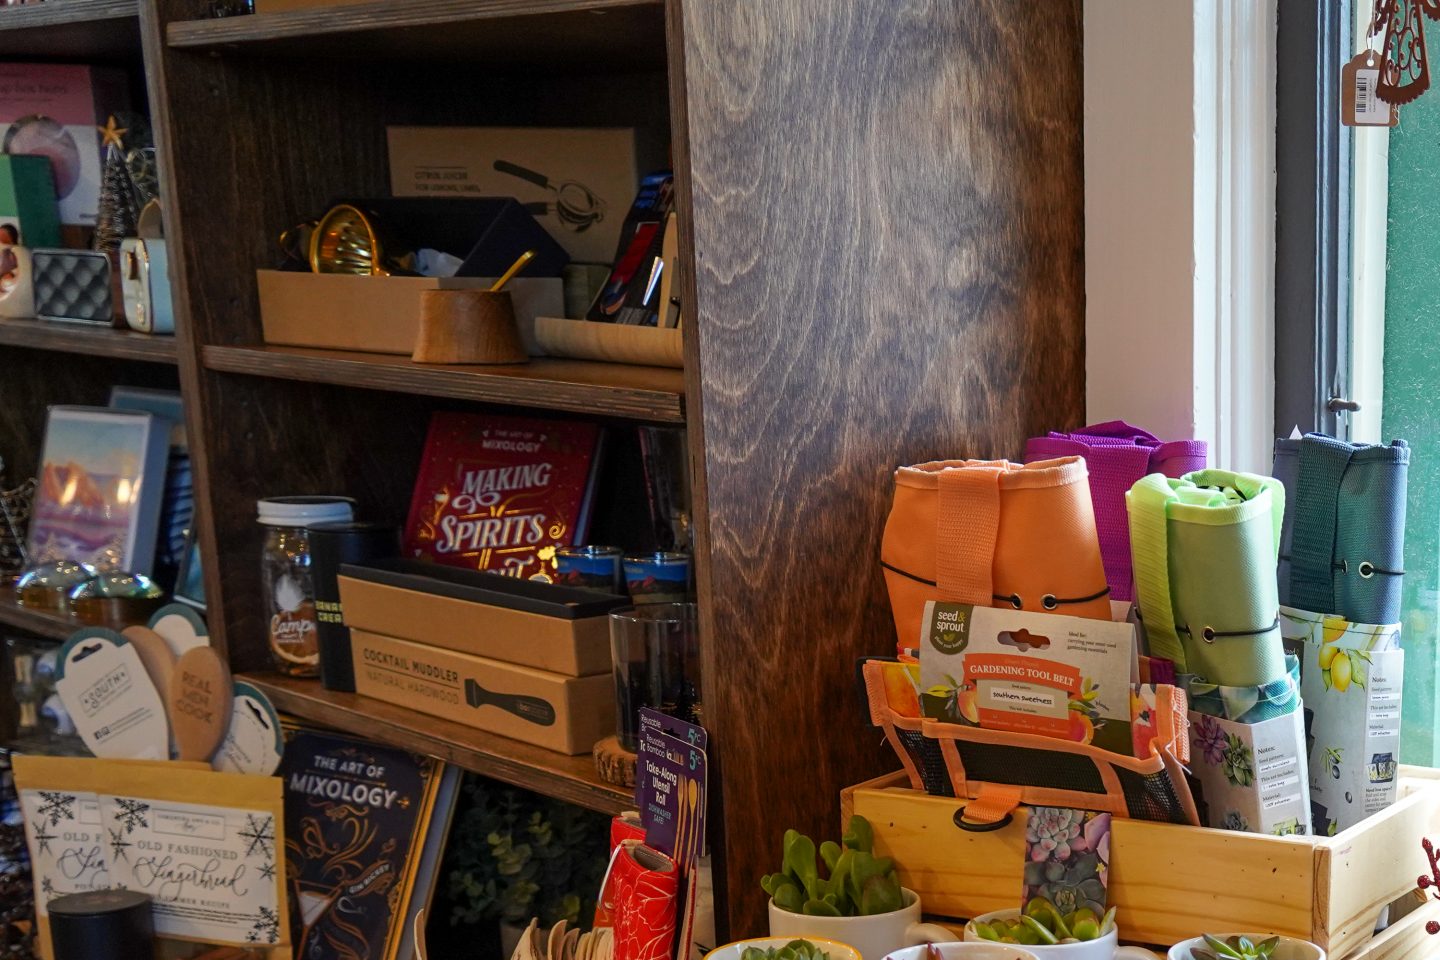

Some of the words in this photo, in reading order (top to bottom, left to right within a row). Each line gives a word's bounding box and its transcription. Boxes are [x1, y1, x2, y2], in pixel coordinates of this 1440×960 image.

[482, 439, 541, 453] MIXOLOGY
[452, 462, 552, 514] MAKING
[436, 513, 546, 553] SPIRITS
[936, 621, 965, 632] sprout
[938, 611, 966, 622] seed&
[363, 647, 411, 672] COCKTAIL
[412, 659, 459, 683] MUDDLER
[182, 671, 213, 694] REAL
[970, 664, 1026, 677] GARDENING
[1026, 668, 1052, 681] TOOL
[1053, 672, 1076, 687] BELT
[366, 669, 406, 691] NATURAL
[407, 680, 460, 705] HARDWOOD
[992, 691, 1021, 701] southern
[1021, 695, 1053, 706] sweetness
[641, 713, 661, 729] Reusable
[646, 733, 666, 750] Reusable
[646, 743, 666, 759] Bamboo
[314, 755, 337, 769] THE
[339, 761, 363, 775] ART
[366, 765, 386, 779] OF
[646, 759, 677, 787] Take-Along
[289, 772, 399, 810] MIXOLOGY
[652, 775, 671, 795] Utensil
[655, 790, 667, 806] Roll
[63, 831, 91, 843] OLD
[137, 840, 162, 852] OLD
[167, 843, 238, 861] FASHIONED
